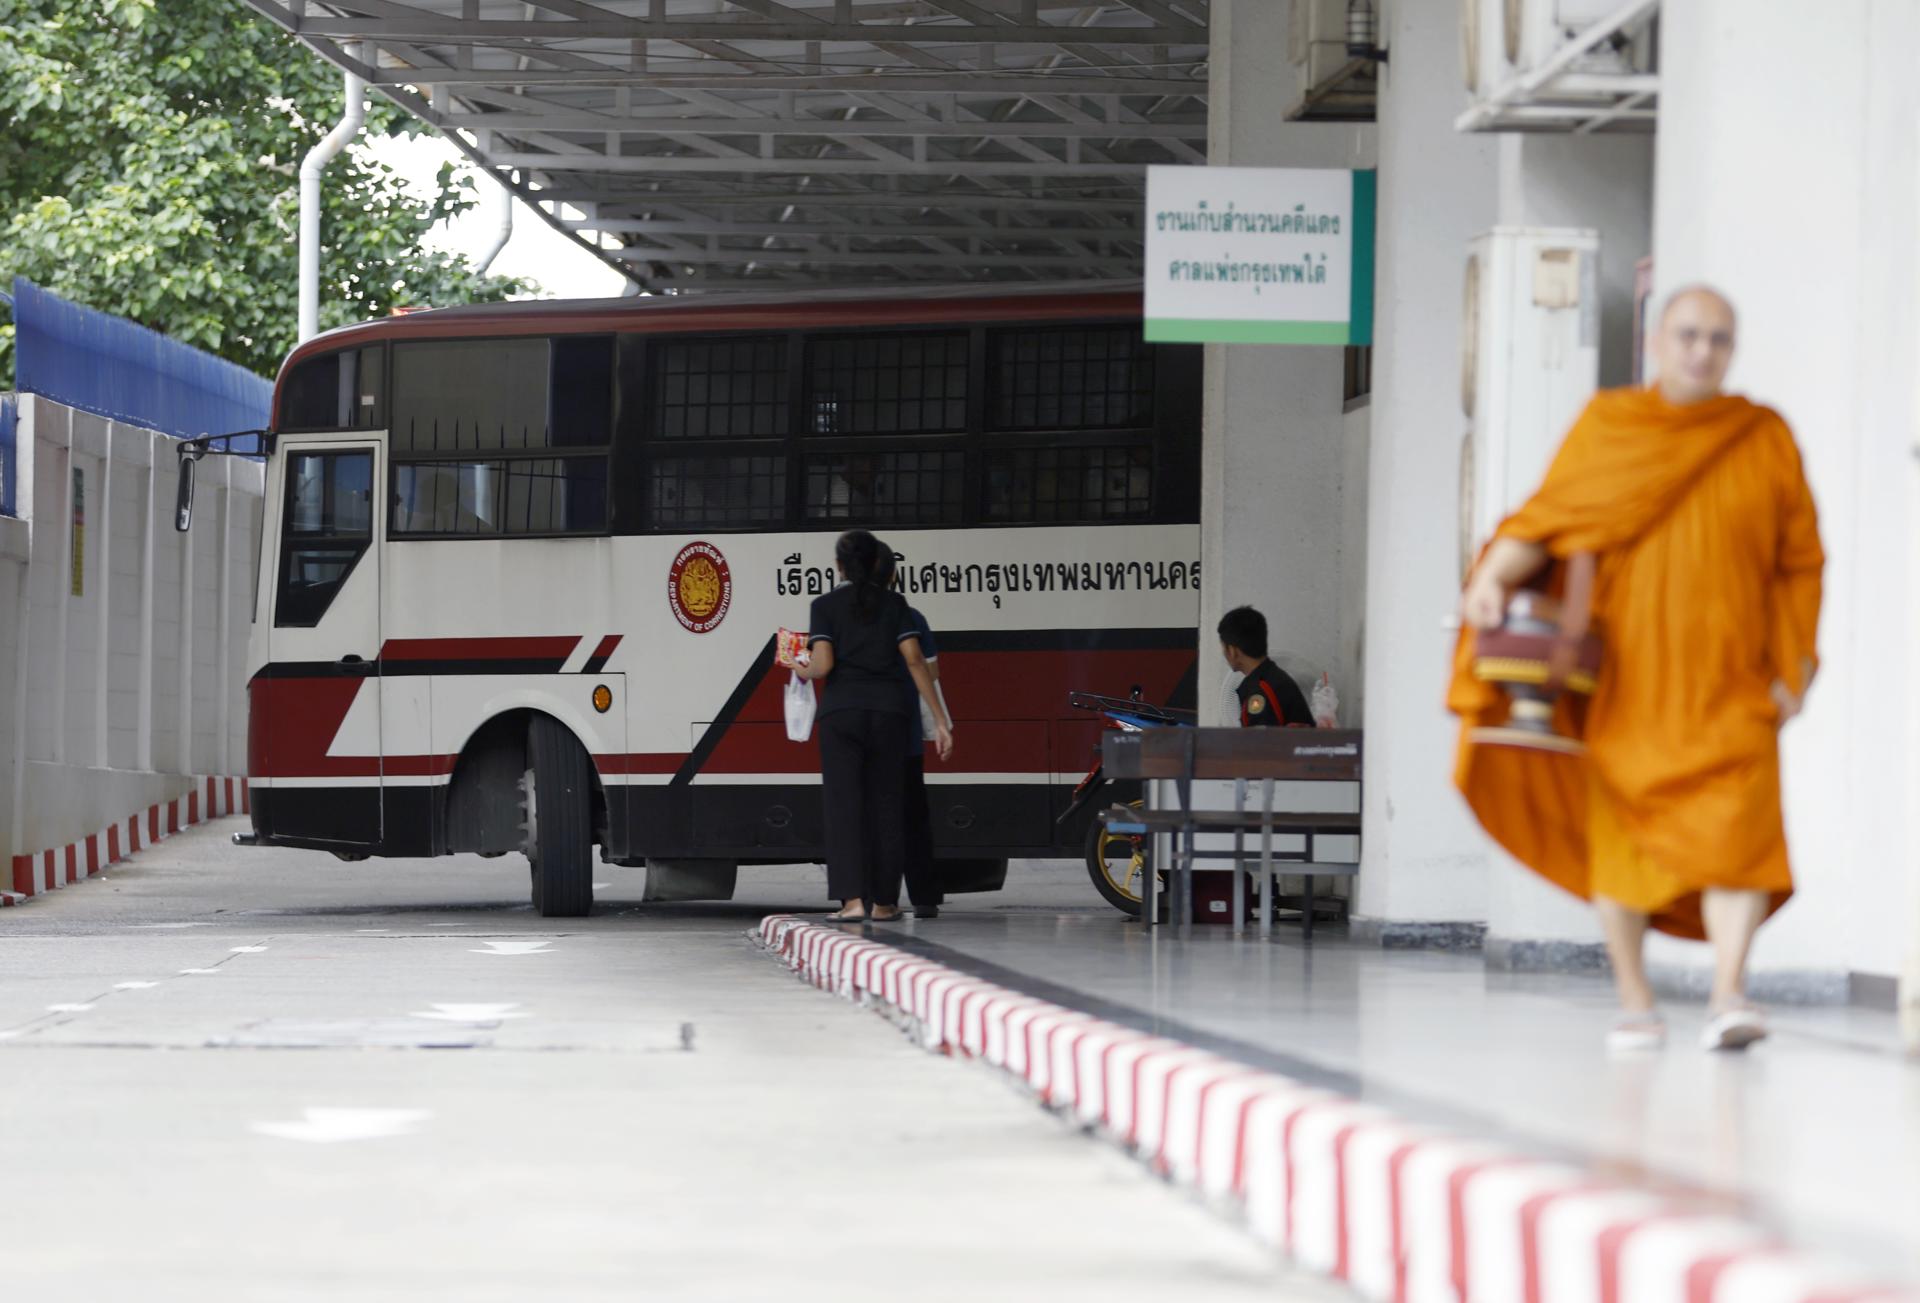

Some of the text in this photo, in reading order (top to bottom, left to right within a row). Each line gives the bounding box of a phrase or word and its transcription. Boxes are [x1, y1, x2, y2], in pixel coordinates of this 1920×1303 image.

[1157, 201, 1341, 235] งานเก็บสำนวนคดีแดง
[1169, 253, 1327, 295] ศาลแพ่งกรุงเทพใต้
[669, 581, 693, 629] DEPARTMENT
